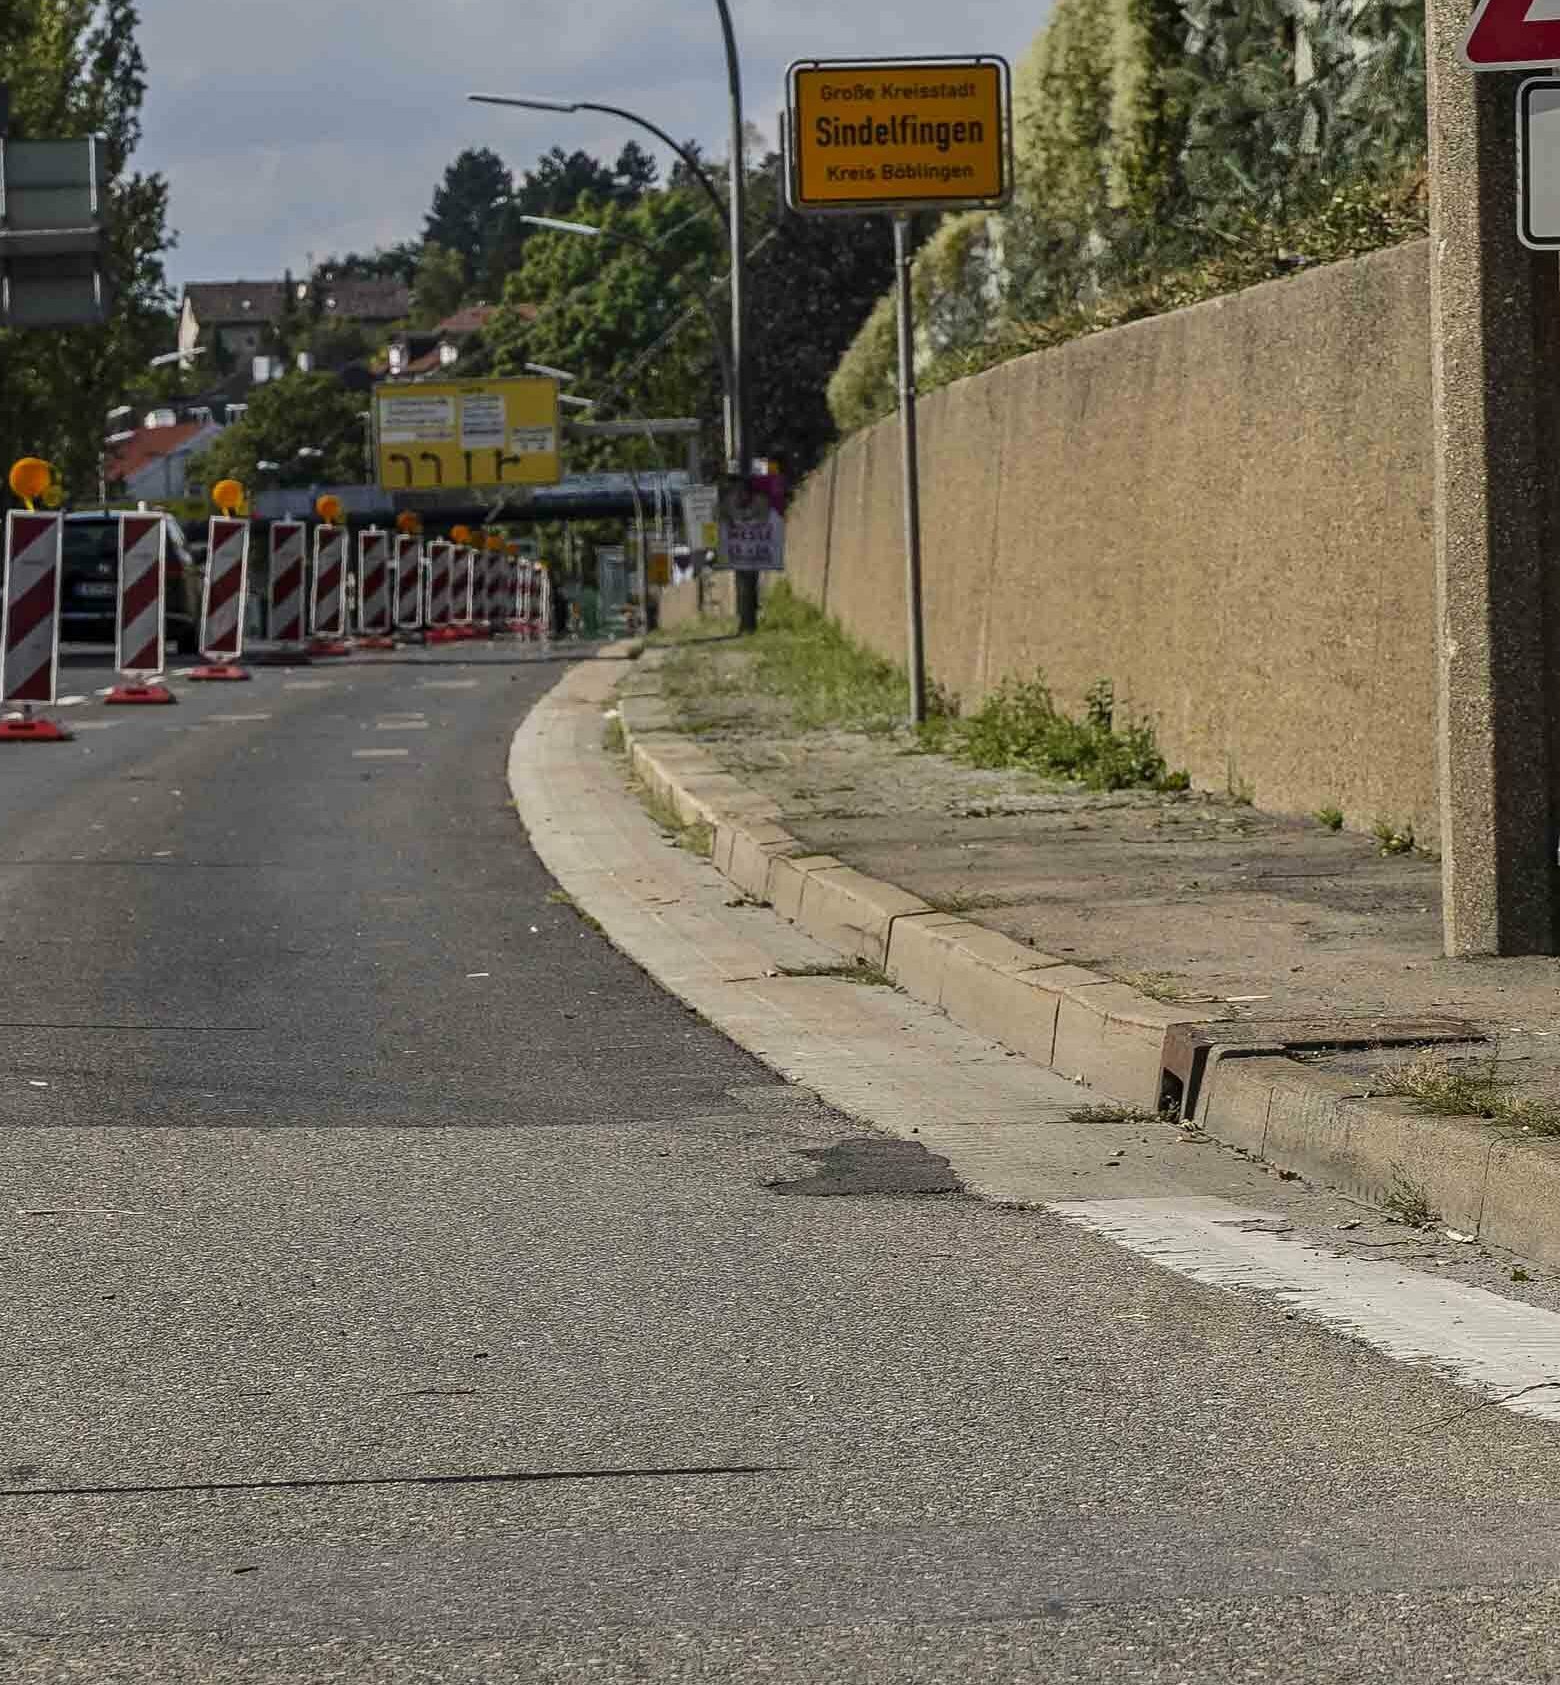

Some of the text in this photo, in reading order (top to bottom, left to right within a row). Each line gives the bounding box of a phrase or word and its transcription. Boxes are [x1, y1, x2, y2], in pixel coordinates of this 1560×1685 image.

[821, 81, 976, 101] Große Kreisstadt
[816, 114, 984, 152] Sindelfingen
[826, 163, 974, 182] Kreis Böblingen
